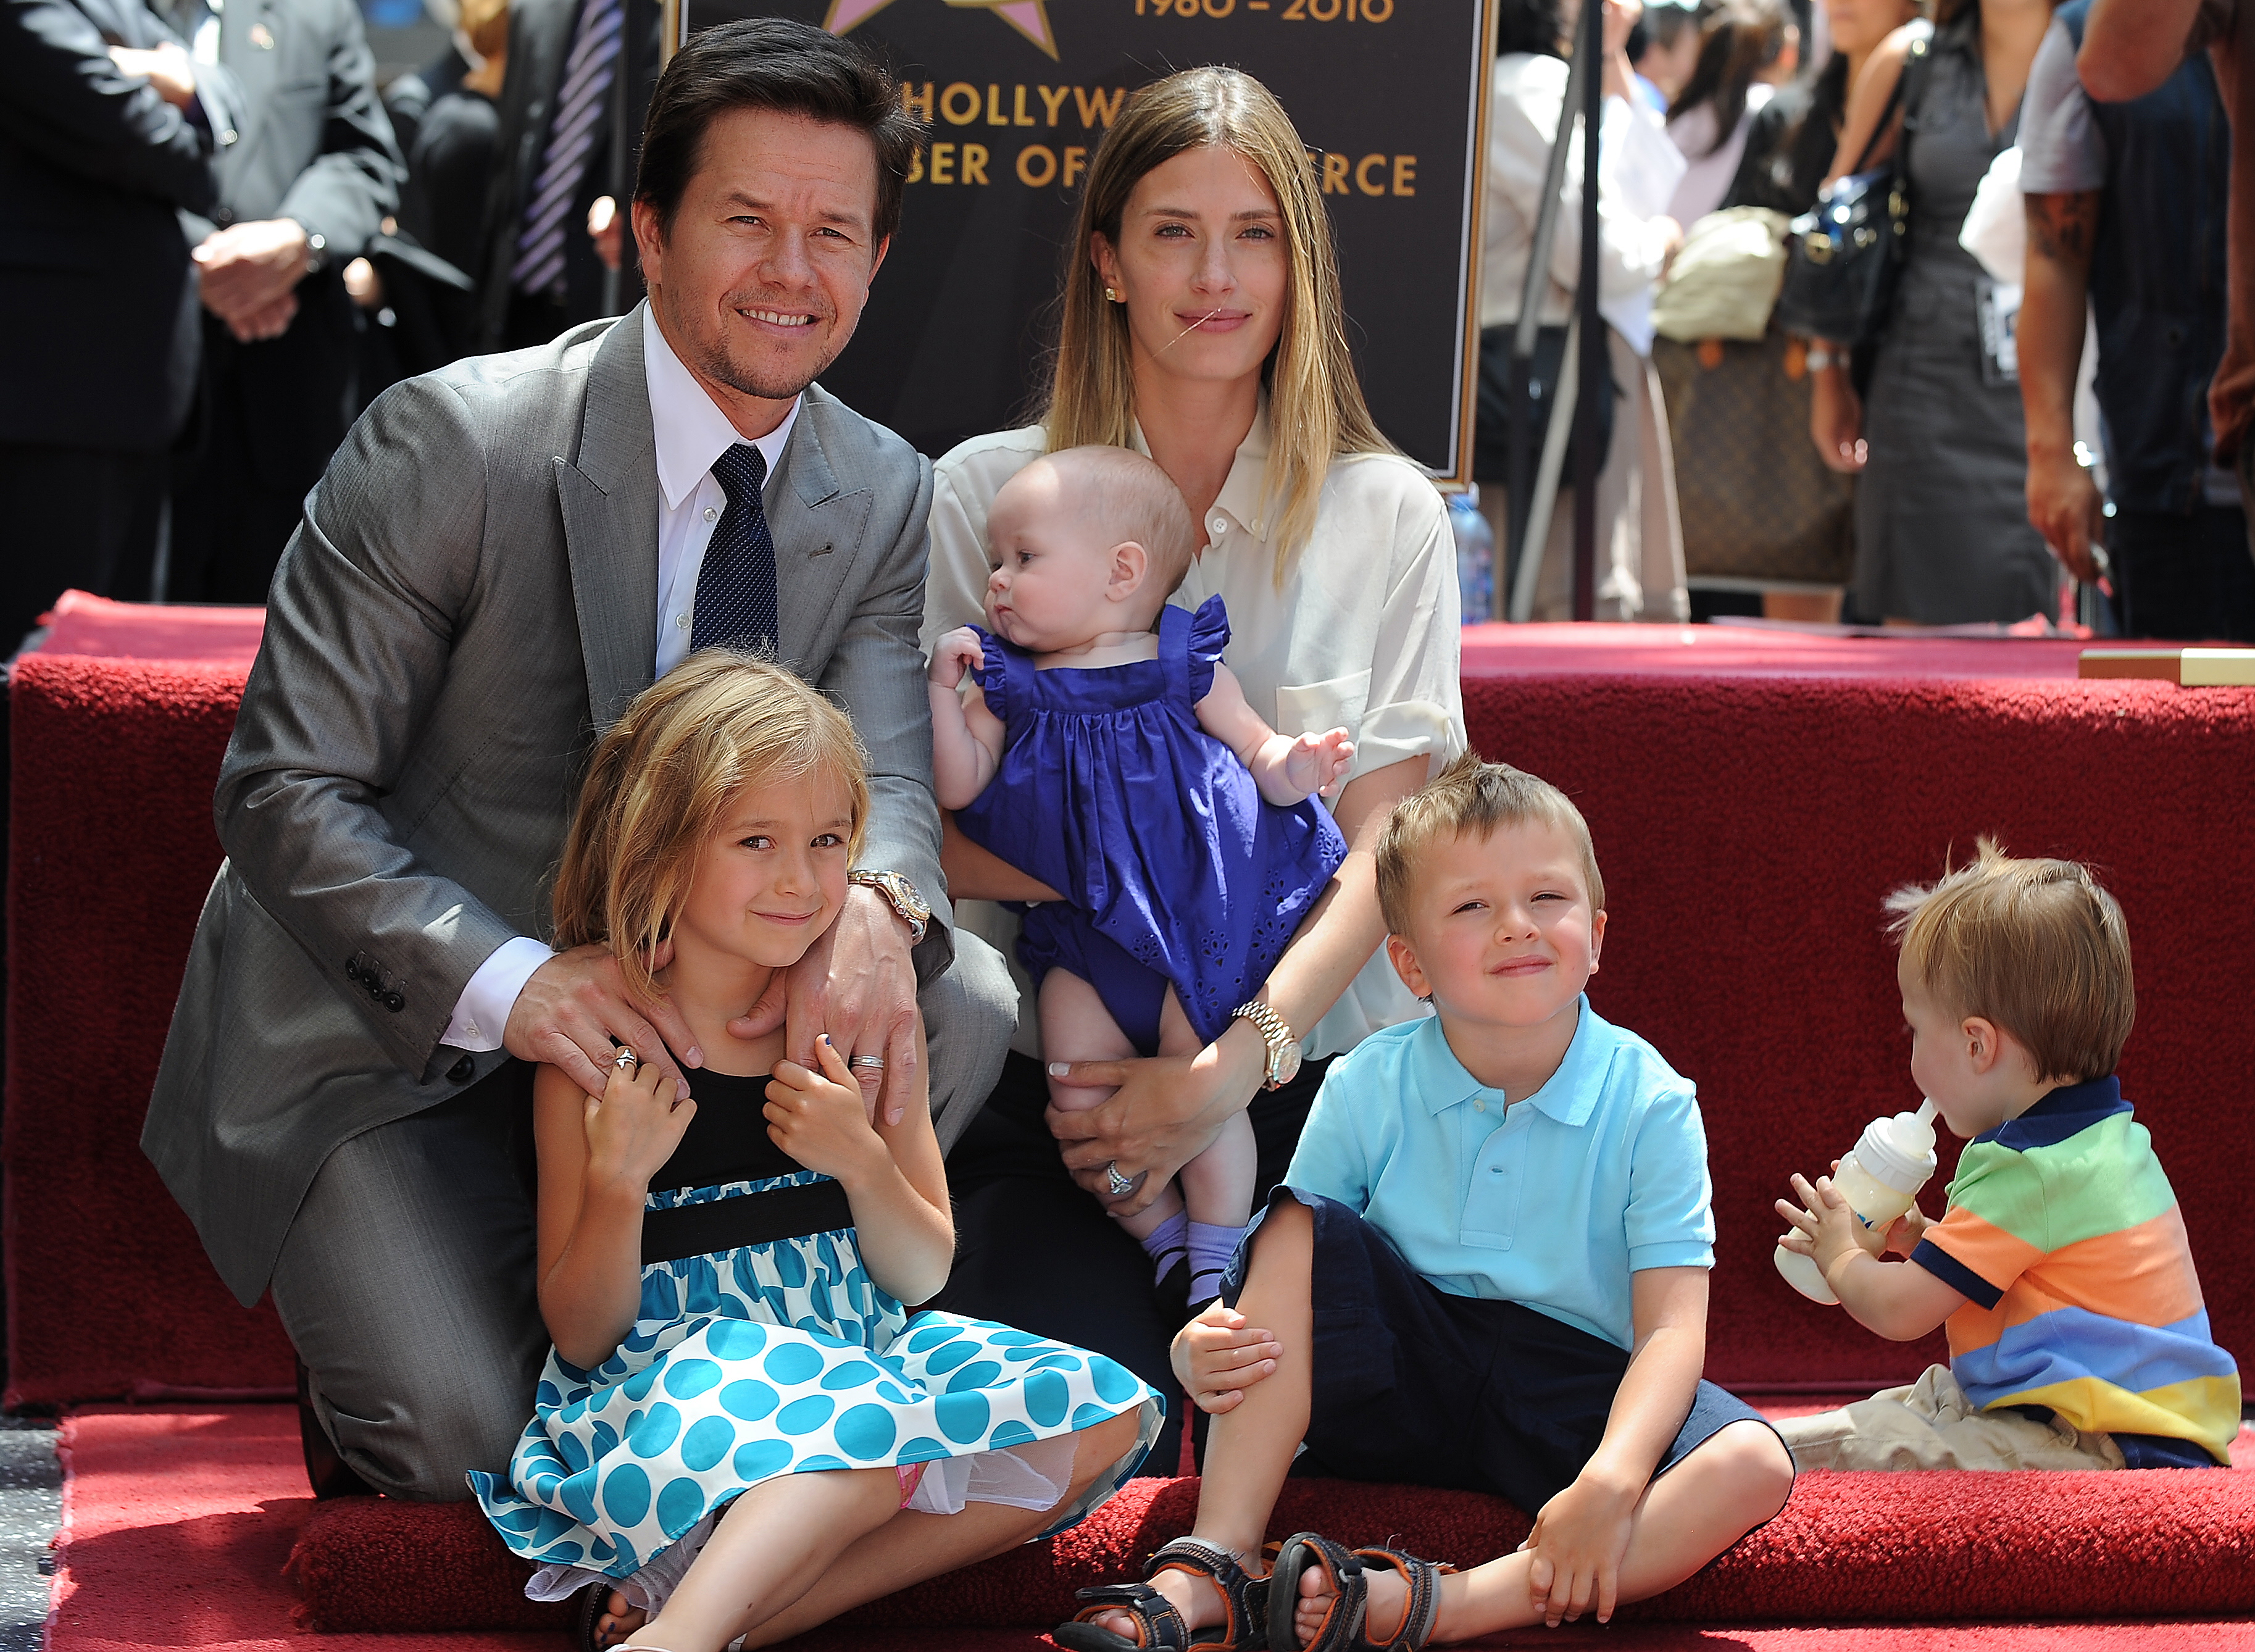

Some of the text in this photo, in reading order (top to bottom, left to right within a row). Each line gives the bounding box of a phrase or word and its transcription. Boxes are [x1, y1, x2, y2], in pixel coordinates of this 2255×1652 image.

[1281, 0, 1395, 23] 2010
[1015, 143, 1087, 188] OF
[1307, 152, 1418, 197] RCE
